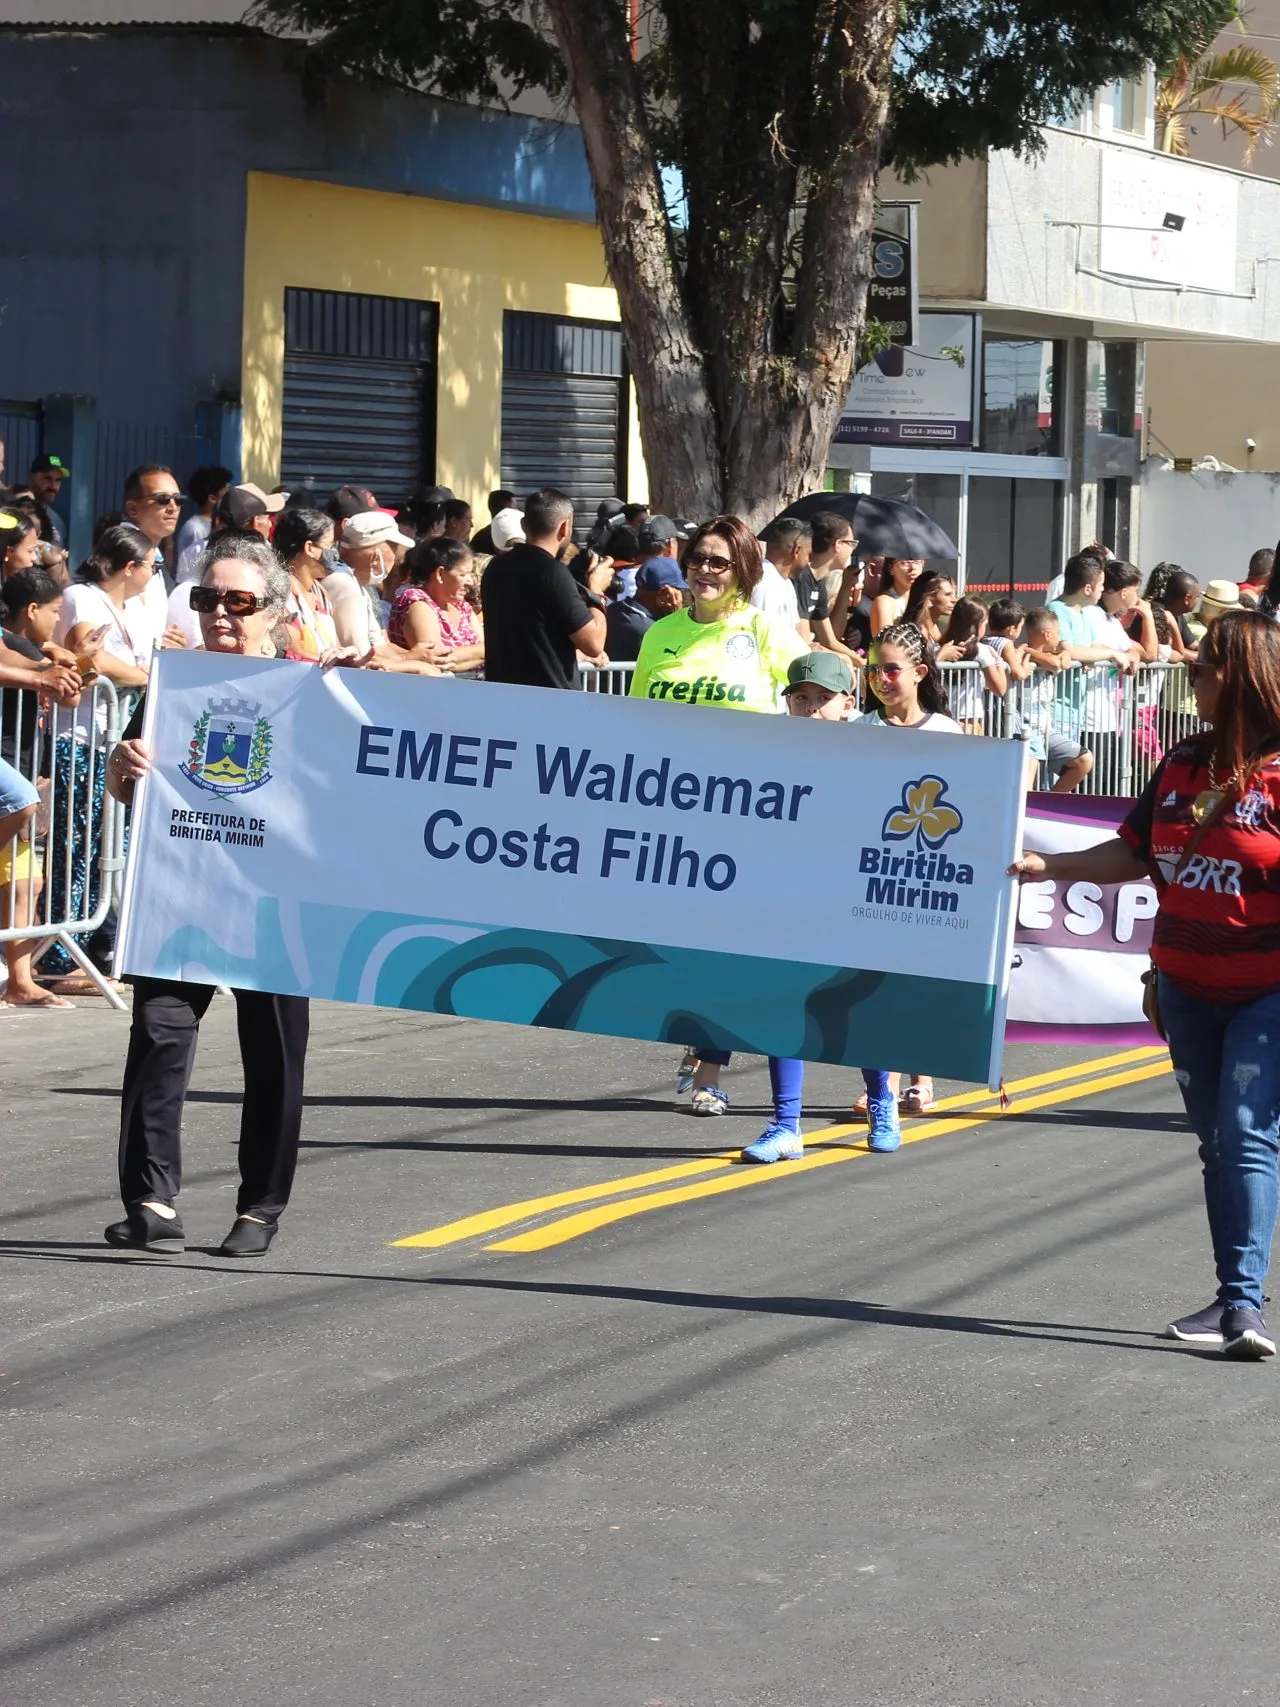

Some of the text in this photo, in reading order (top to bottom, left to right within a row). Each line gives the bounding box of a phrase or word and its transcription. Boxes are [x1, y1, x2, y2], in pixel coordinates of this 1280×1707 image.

[871, 284, 907, 299] Peças
[648, 676, 746, 704] crefisa
[355, 725, 813, 822] EMEF Waldemar
[171, 809, 266, 831] PREFEITURA DE
[169, 825, 264, 847] BIRITIBA MIRIM
[423, 809, 737, 891] Costa Filho
[859, 847, 974, 884] Biritiba
[1179, 857, 1243, 896] BRB
[866, 877, 959, 912] Mirim
[852, 906, 969, 929] ORGULHO DE VIVER AQUI
